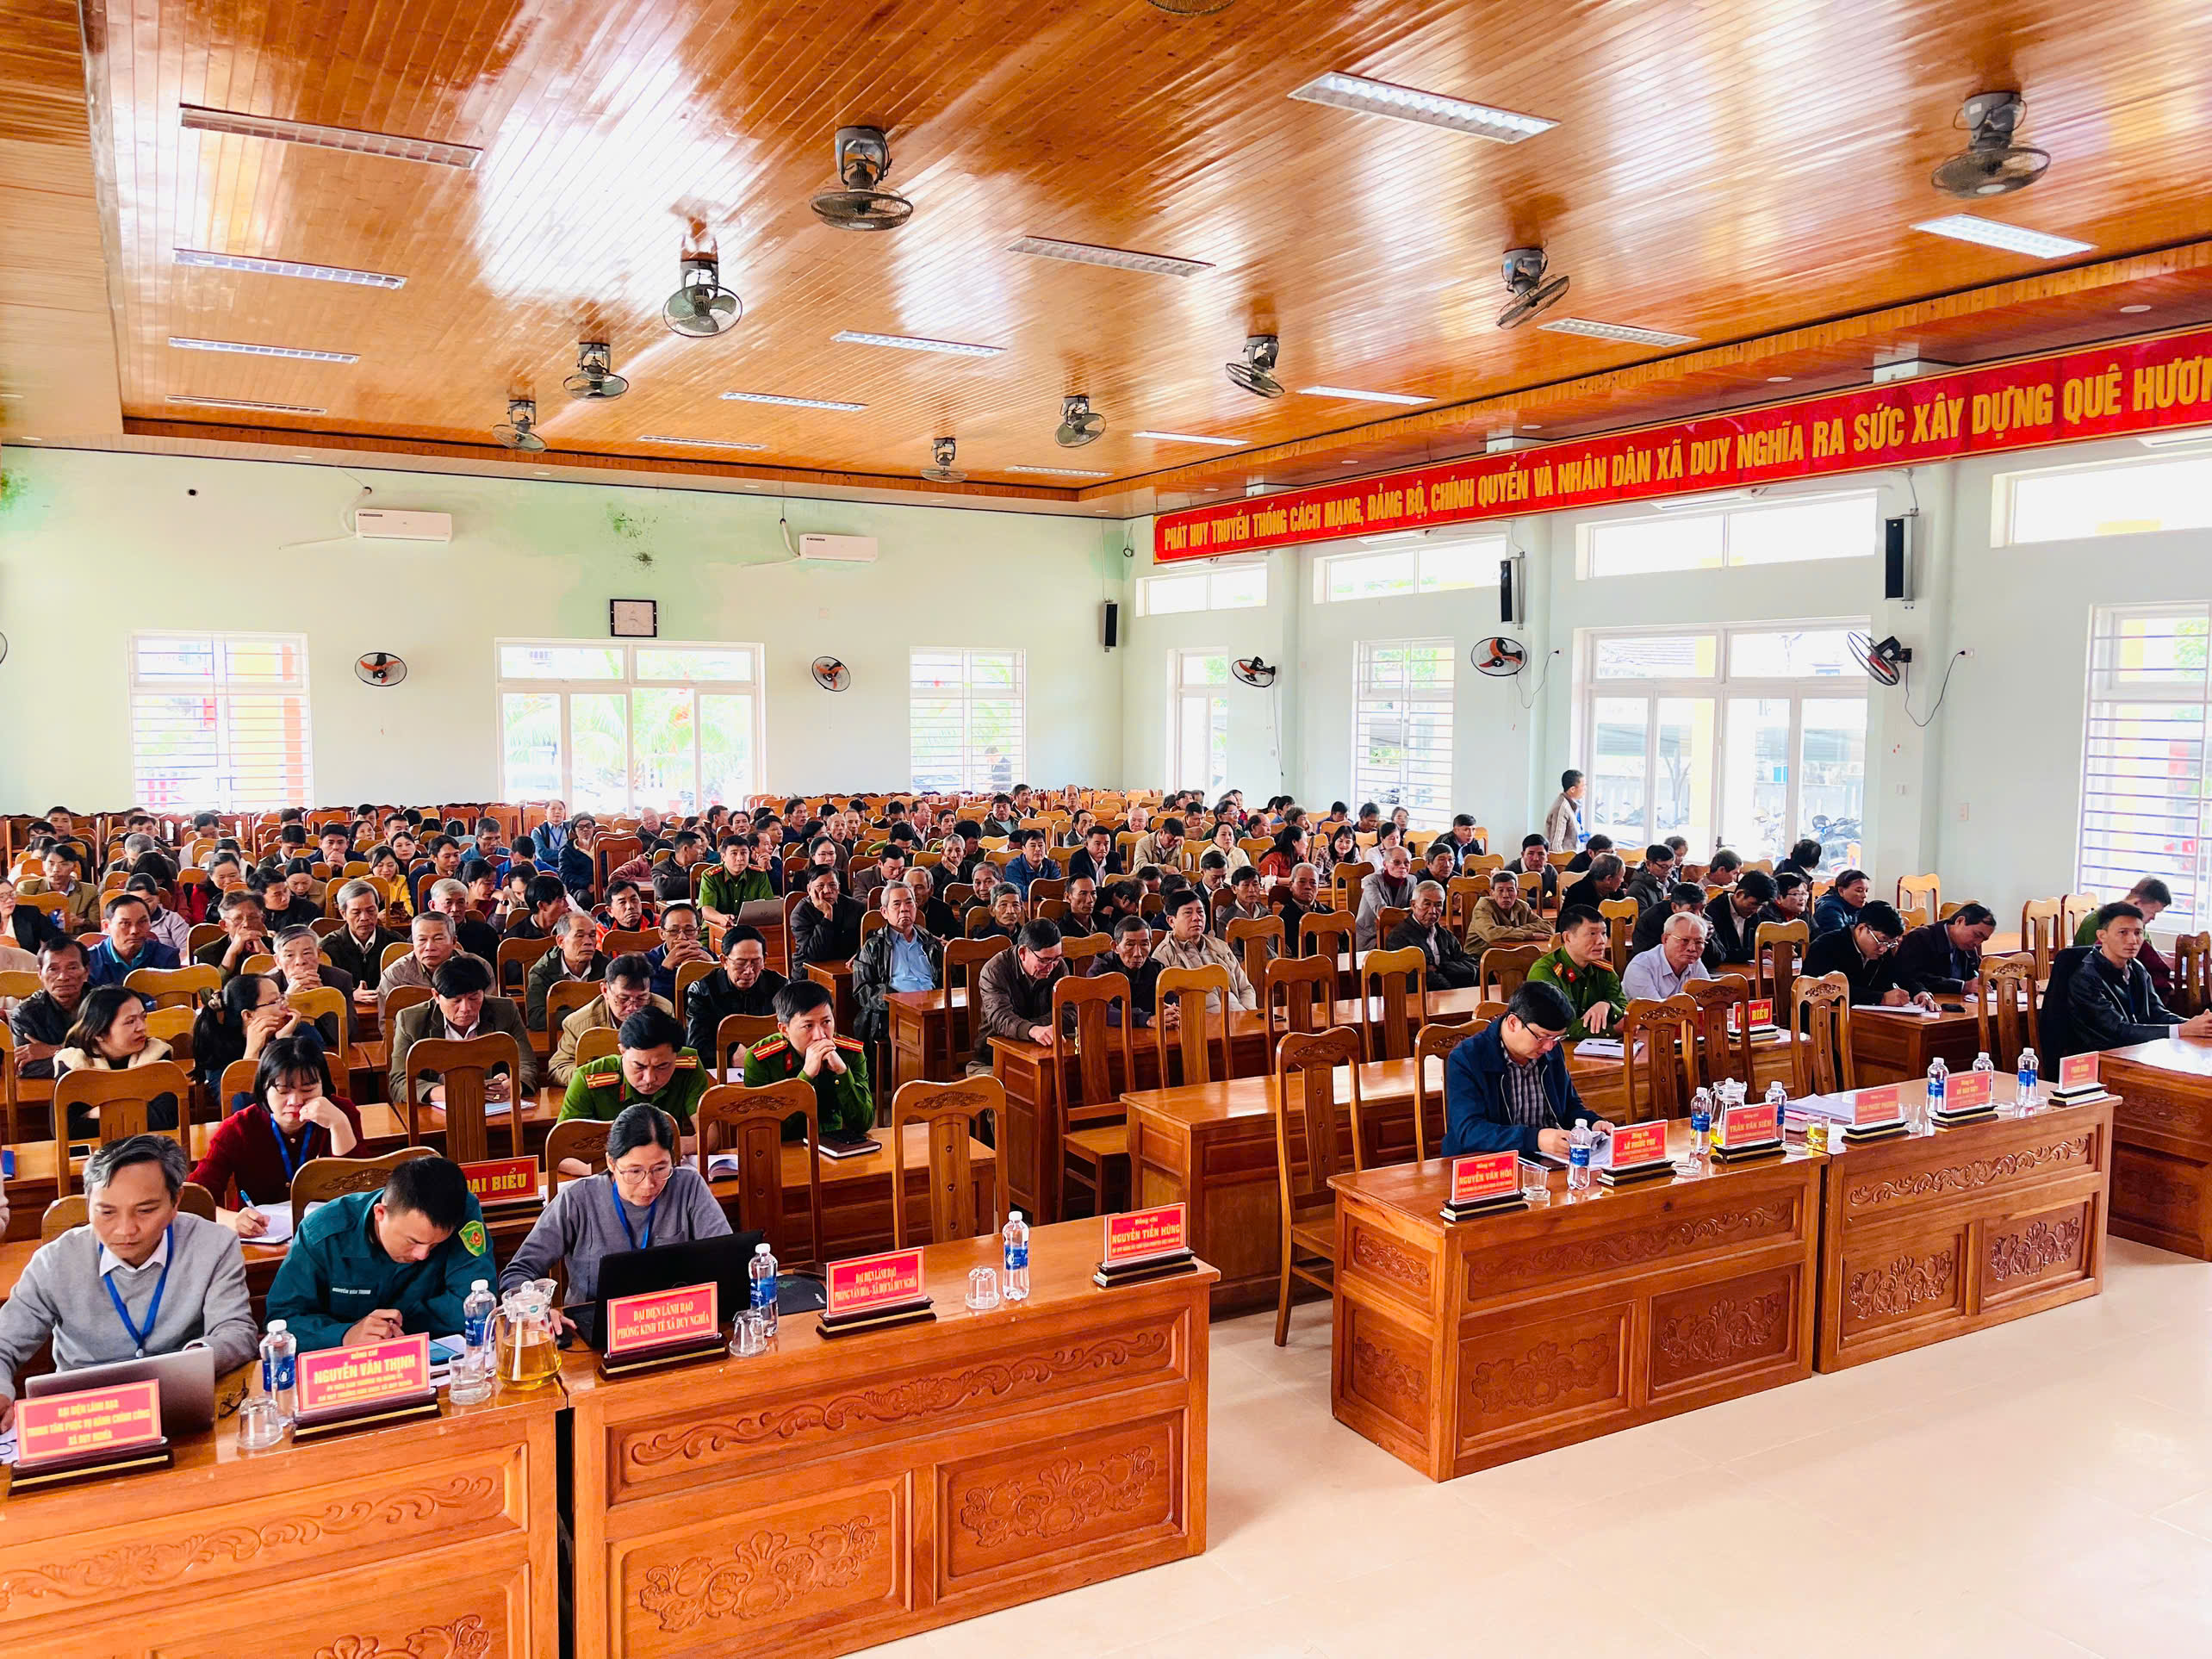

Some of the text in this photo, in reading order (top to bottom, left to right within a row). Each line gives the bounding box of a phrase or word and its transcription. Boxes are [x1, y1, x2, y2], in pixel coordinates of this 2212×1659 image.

[1165, 521, 1188, 550] PHÁT
[1190, 521, 1209, 547] HUY
[1212, 508, 1250, 544] TRUYỀN
[1253, 502, 1288, 537] THỐNG
[1289, 500, 1321, 532] CÁCH
[1324, 496, 1364, 531] MẠNG,
[1367, 482, 1403, 522] ĐẢNG
[1406, 480, 1428, 519] BỘ,
[1431, 475, 1475, 512] CHÍNH
[1477, 461, 1530, 508] QUYỀN
[1533, 459, 1554, 498] VÀ
[1557, 452, 1608, 494] NHÂN
[1612, 445, 1652, 487] DÂN
[1656, 438, 1683, 481] XÃ
[1690, 435, 1732, 476] DUY
[1737, 420, 1805, 469] NGHĨA
[1812, 418, 1846, 458] RA
[1853, 403, 1905, 452] SỨC
[1911, 392, 1965, 444] XÂY
[1972, 383, 2054, 440] DỰNG
[2063, 363, 2123, 426] QUÊ
[491, 1167, 527, 1191] BIỂU
